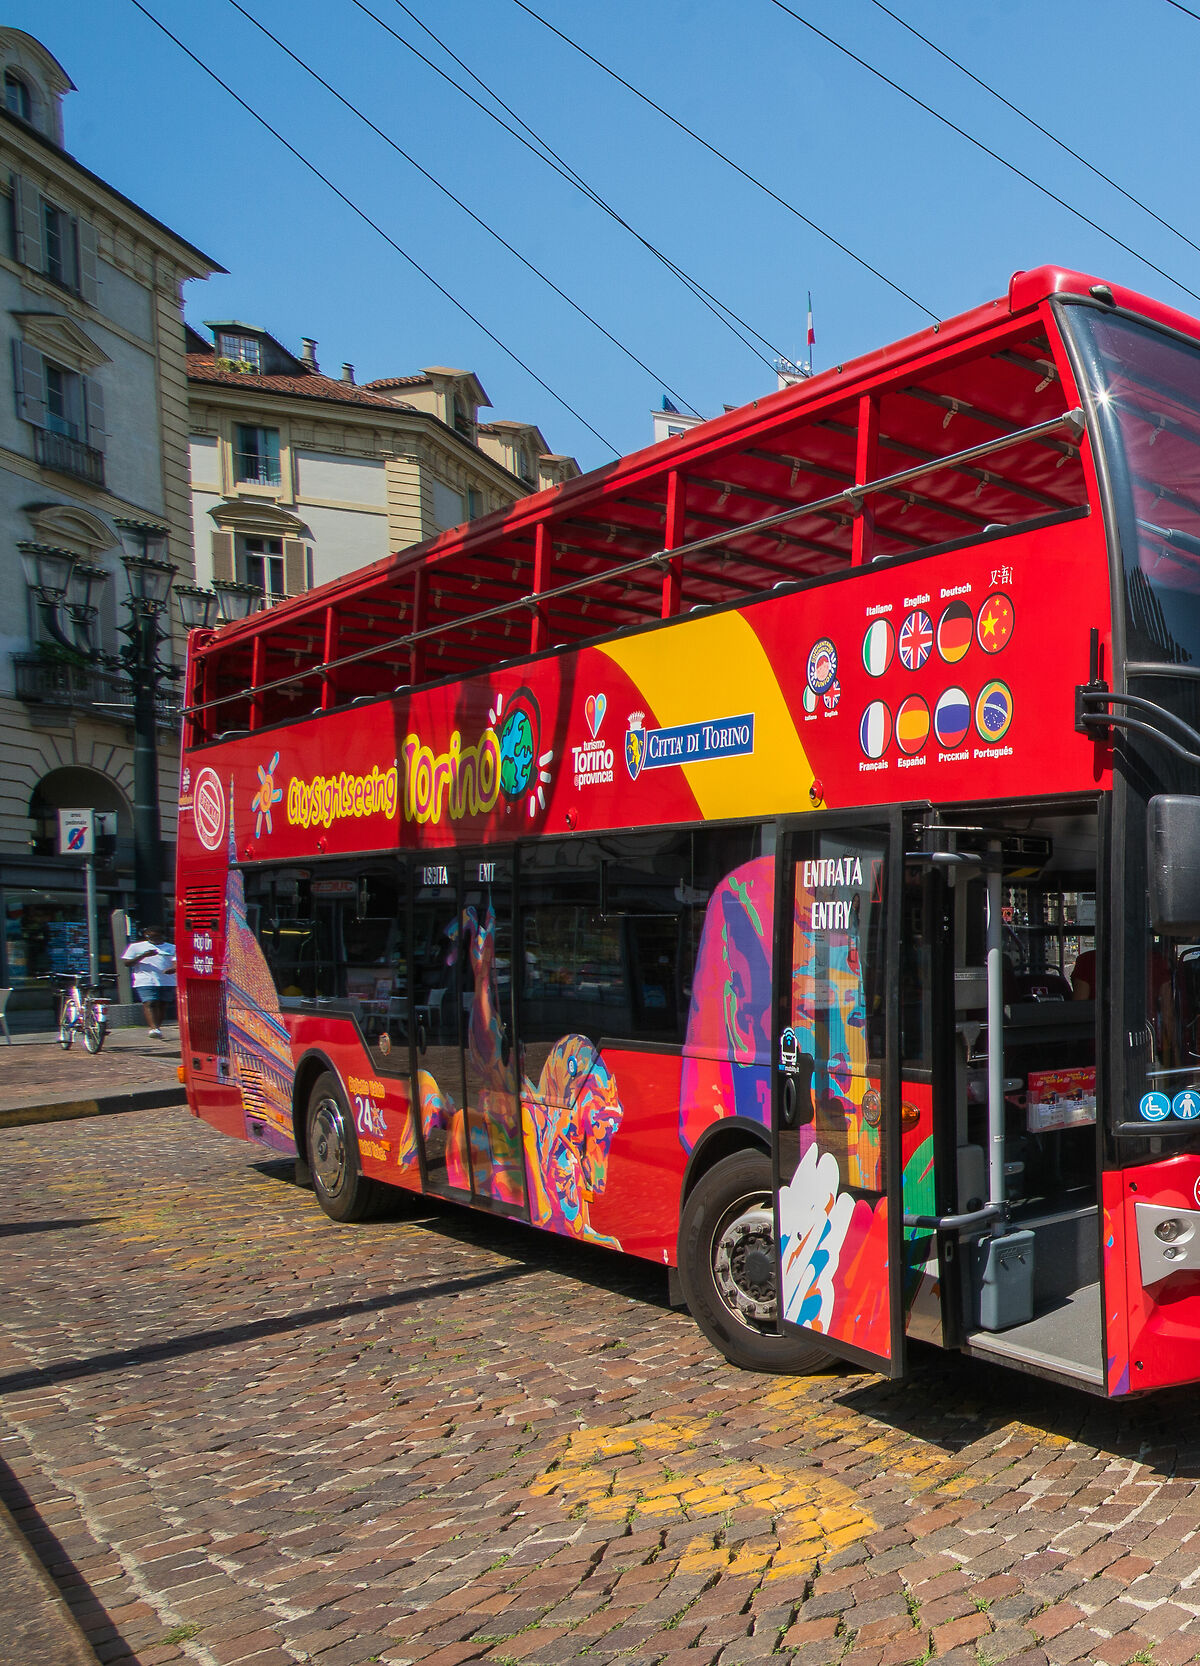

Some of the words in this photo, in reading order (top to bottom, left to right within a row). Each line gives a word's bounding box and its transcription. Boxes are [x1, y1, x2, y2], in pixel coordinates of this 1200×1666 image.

[940, 583, 972, 598] Deutsch
[903, 594, 931, 608] English
[866, 603, 893, 616] Italiano
[815, 672, 833, 688] JUNIOR
[583, 739, 606, 750] turismo
[687, 733, 700, 753] DI
[702, 725, 750, 750] TORINO
[572, 746, 615, 774] Torino
[973, 746, 1014, 759] Português
[859, 760, 889, 772] Français
[897, 756, 927, 769] Español
[287, 765, 398, 829] CitySightseeing
[402, 730, 502, 824] Torino
[479, 862, 496, 882] EXIT
[803, 857, 863, 888] ENTRATA
[811, 900, 853, 930] ENTRY
[355, 1096, 373, 1132] 24
